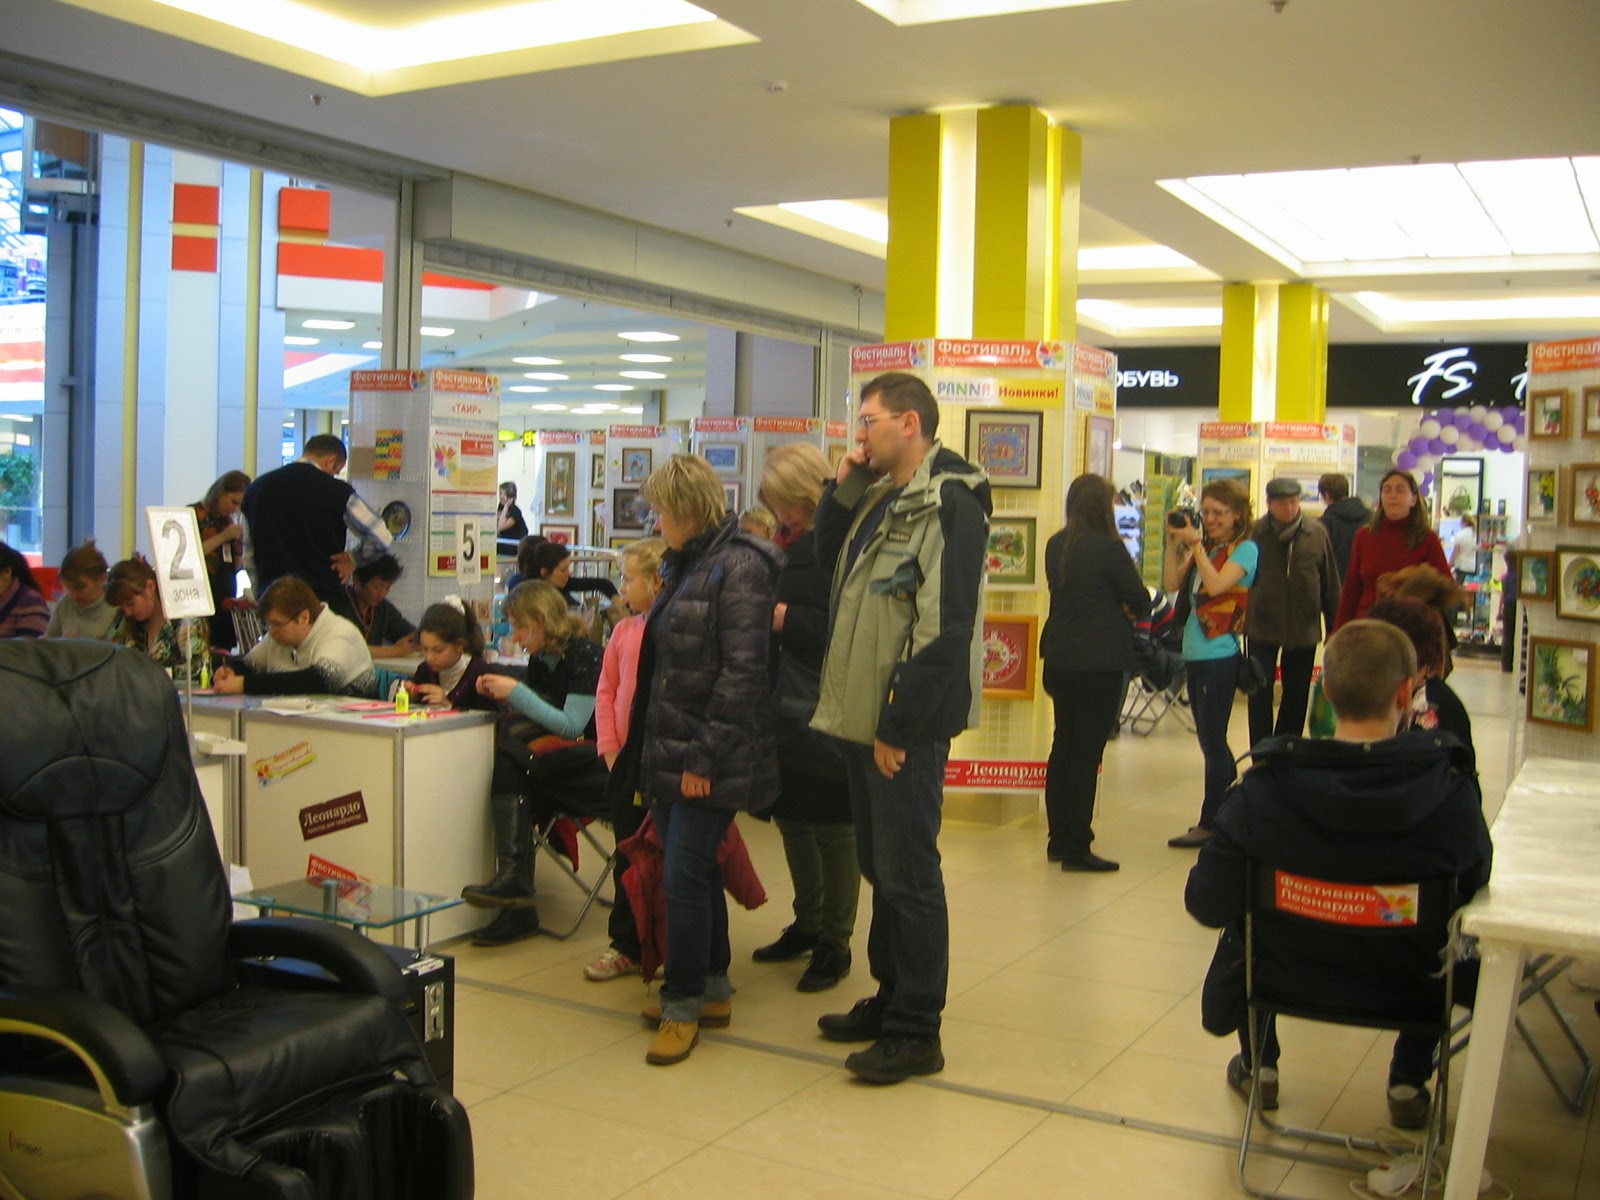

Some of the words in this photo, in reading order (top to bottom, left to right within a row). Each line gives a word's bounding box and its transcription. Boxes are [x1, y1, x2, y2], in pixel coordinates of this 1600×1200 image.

[854, 347, 906, 360] Фестиваль
[938, 341, 1031, 357] Фестиваль
[353, 371, 406, 383] Фестиваль
[436, 371, 483, 384] Фестиваль
[1406, 346, 1477, 405] FS
[937, 382, 991, 395] PANNA
[999, 386, 1059, 399] Новинки!
[611, 425, 652, 434] Фестиваль
[756, 419, 803, 428] Фестиваль
[1202, 424, 1244, 432] Фестиваль
[1266, 423, 1320, 433] Фестиваль
[162, 519, 194, 580] 2
[462, 523, 475, 562] 5
[173, 588, 200, 603] зона
[965, 762, 1047, 778] Леонардо
[304, 799, 361, 827] Леонардо
[1280, 875, 1376, 901] Фестиваль
[1281, 888, 1365, 914] Леонардо
